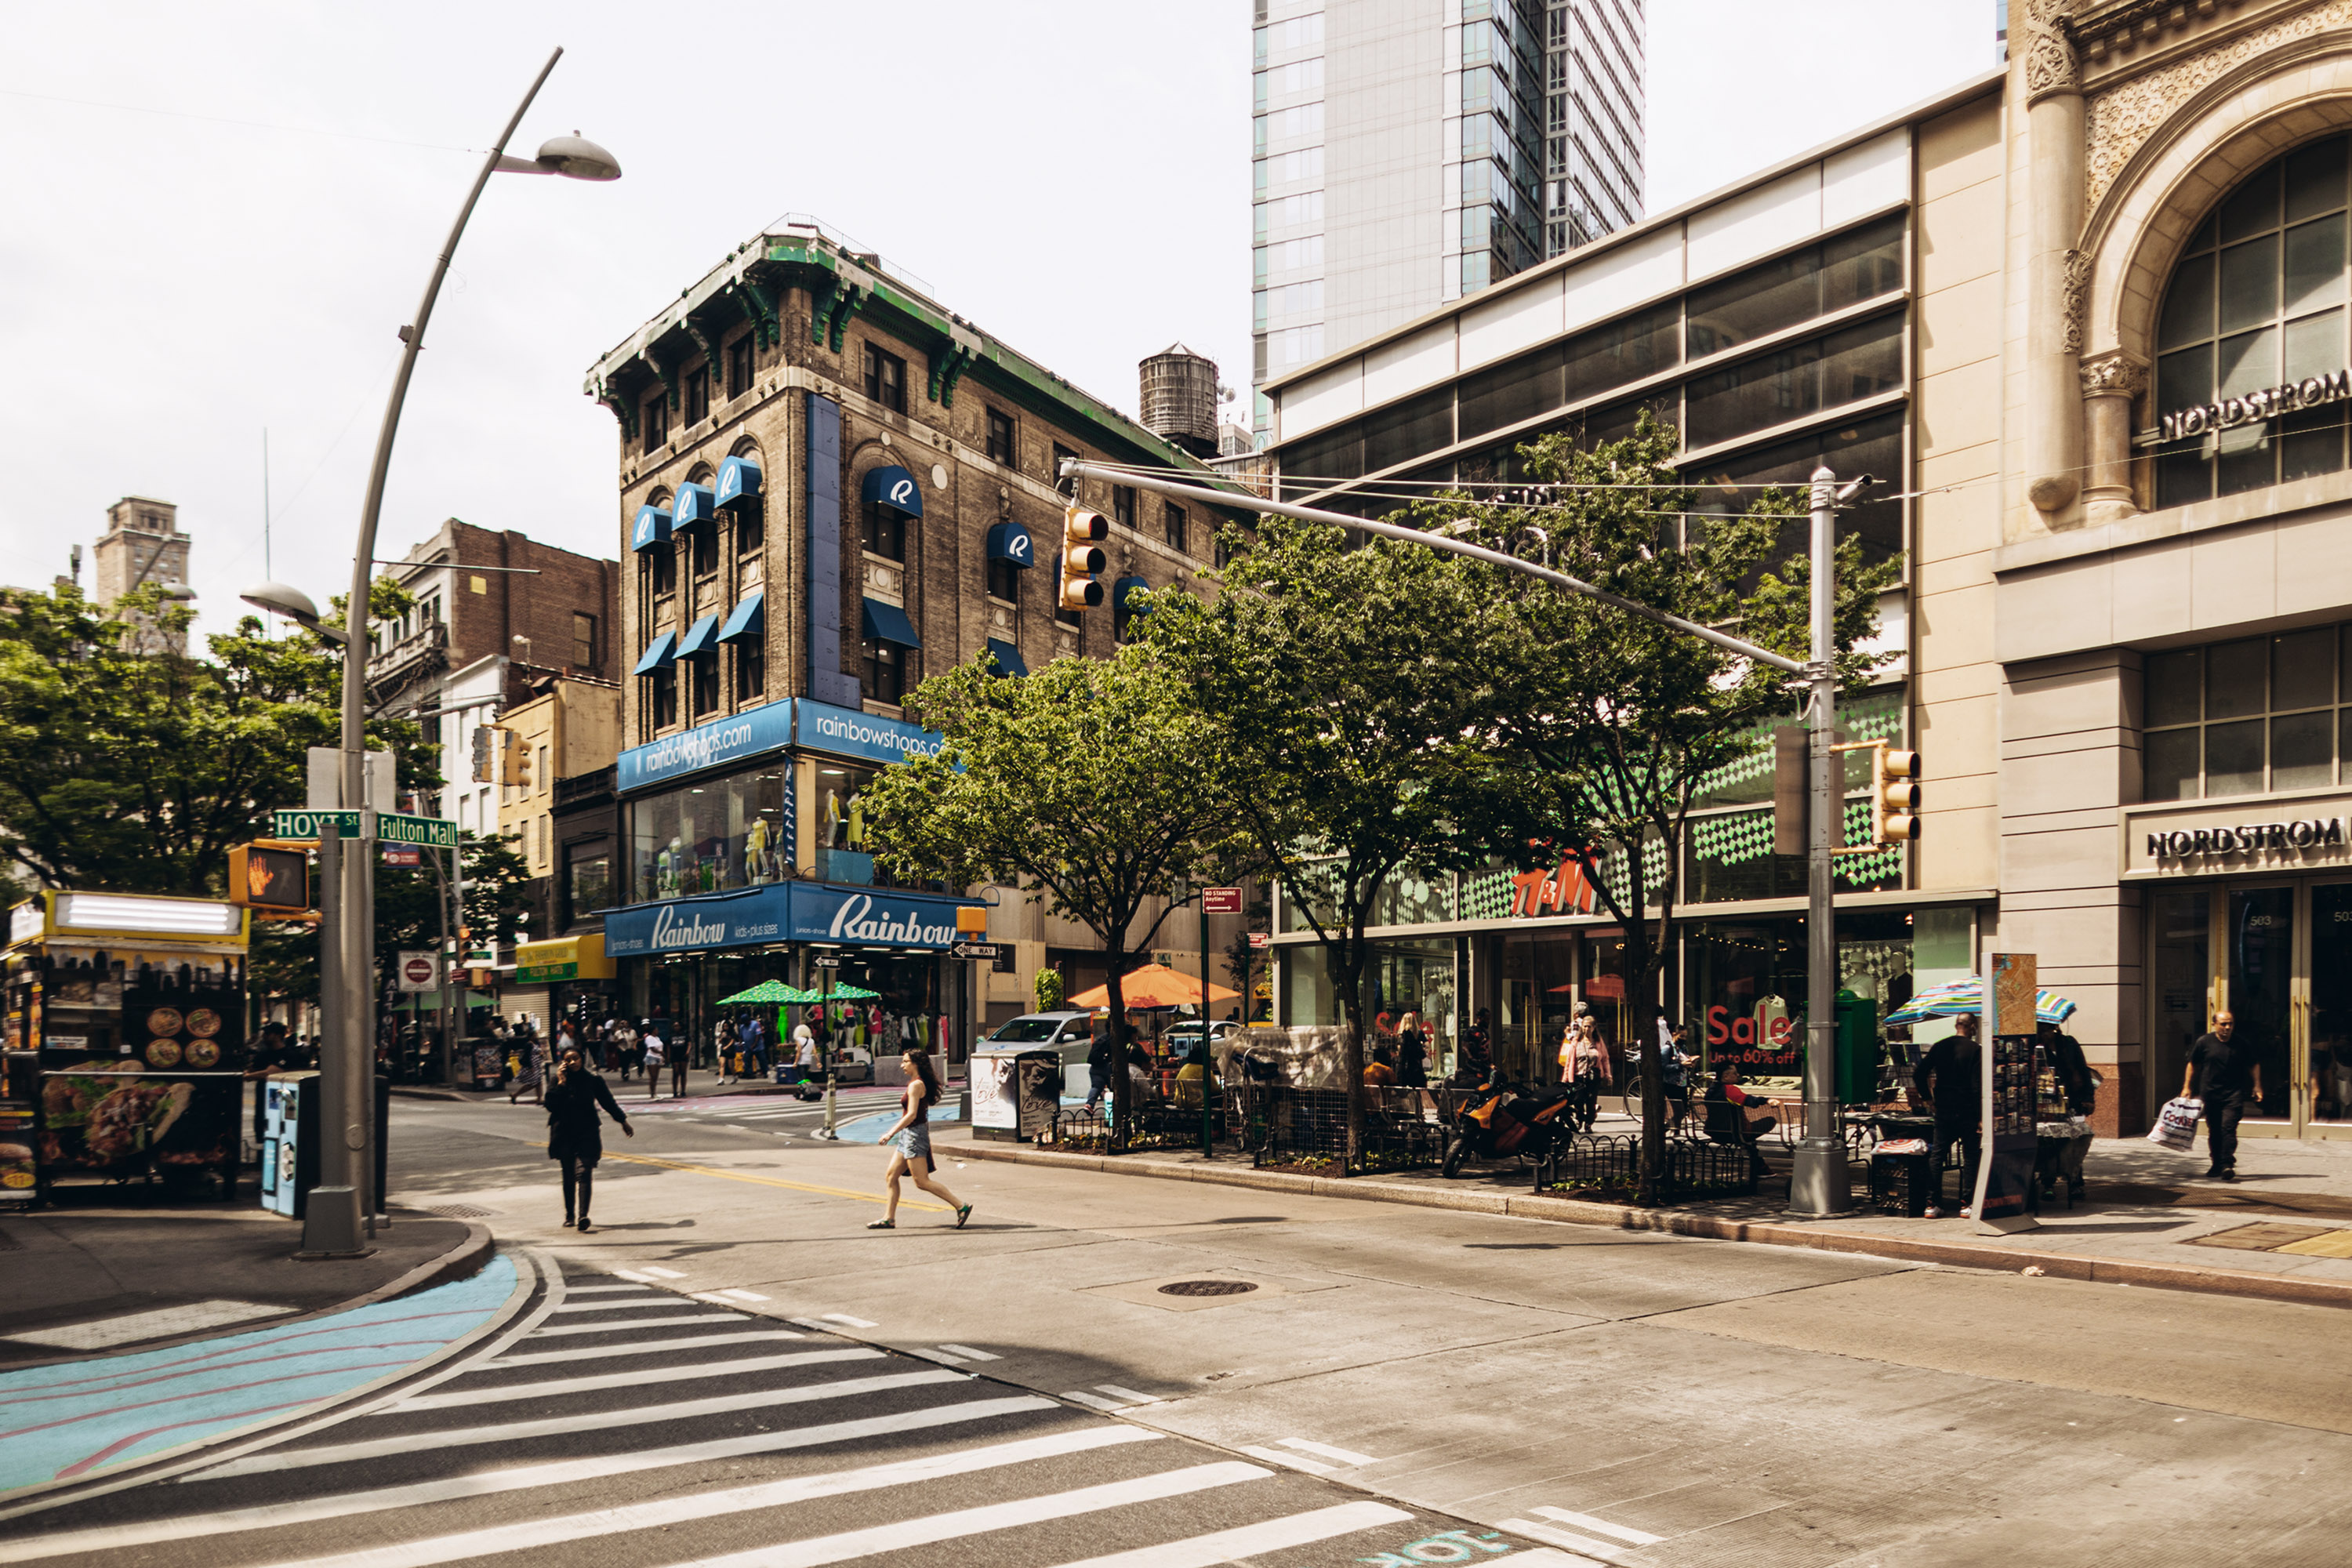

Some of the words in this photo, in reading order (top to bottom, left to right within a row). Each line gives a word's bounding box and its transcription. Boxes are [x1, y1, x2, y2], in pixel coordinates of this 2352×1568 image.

[2160, 369, 2352, 443] NORDSTROM
[720, 464, 735, 498] R
[890, 480, 913, 504] R
[677, 490, 691, 521] R
[636, 513, 650, 543] R
[1009, 535, 1029, 557] R
[647, 724, 751, 772] rainbowshops.com
[817, 717, 946, 758] rainbowshops.c
[346, 815, 358, 826] St
[380, 817, 425, 841] Fulton
[429, 823, 456, 845] Mall
[2147, 817, 2345, 858] NORDSTROM
[652, 905, 725, 949] Rainbow
[829, 894, 956, 944] Rainbow
[2251, 916, 2271, 927] 503
[958, 946, 973, 955] ONE
[979, 947, 994, 956] WAY
[1708, 1004, 1793, 1045] Sale
[1710, 1051, 1726, 1063] Up
[1727, 1054, 1740, 1064] to
[1743, 1049, 1774, 1064] 60%
[1776, 1052, 1795, 1064] off
[975, 1077, 998, 1105] Love
[1022, 1092, 1053, 1114] Love
